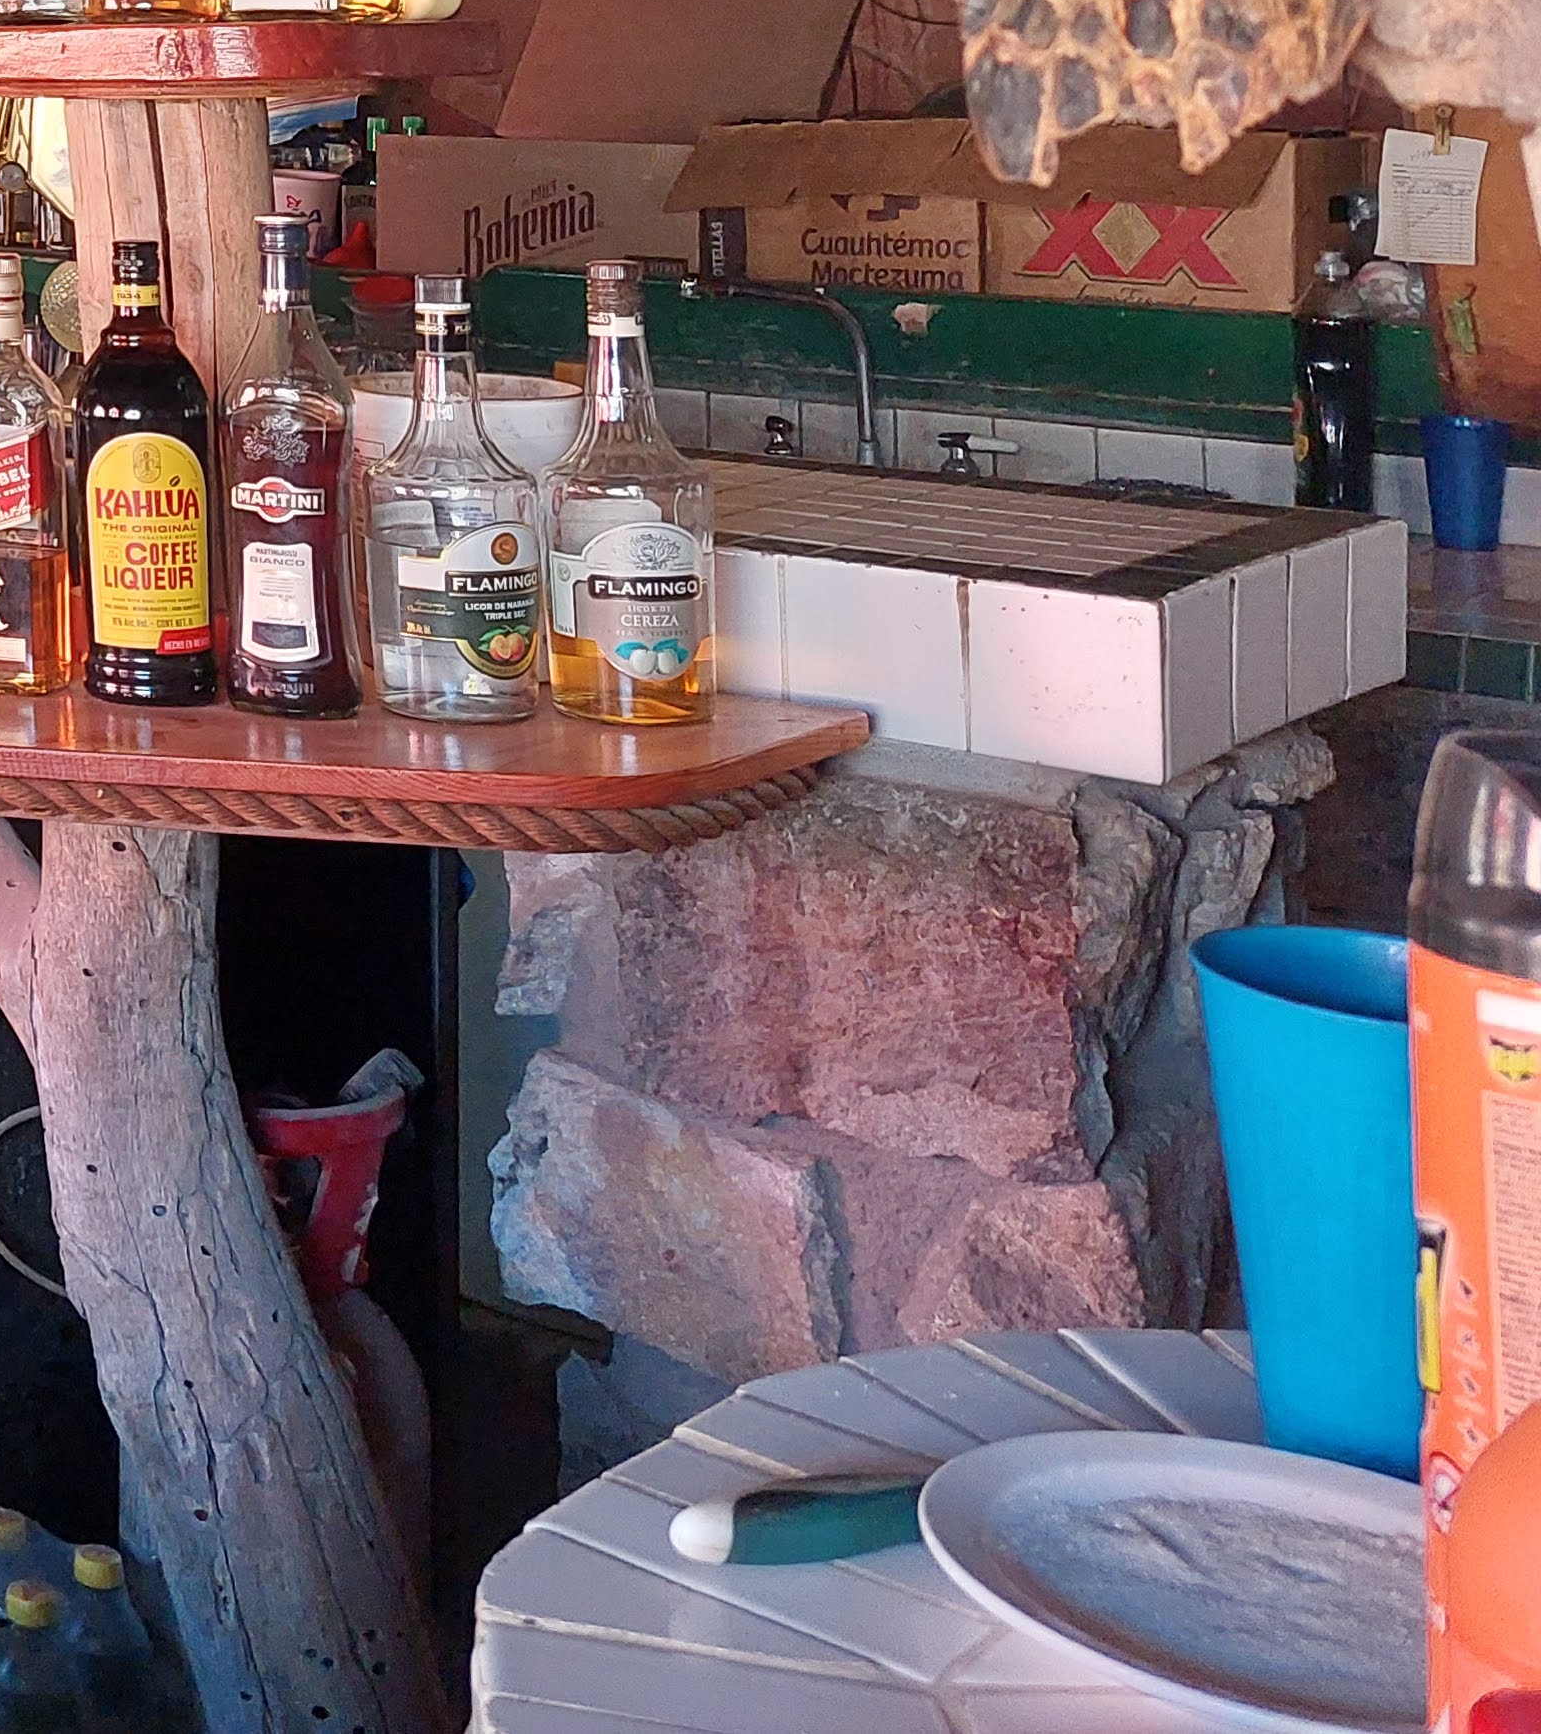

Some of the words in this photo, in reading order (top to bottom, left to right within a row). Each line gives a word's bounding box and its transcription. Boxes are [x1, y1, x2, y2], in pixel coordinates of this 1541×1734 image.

[463, 183, 595, 278] Bohemia
[710, 221, 725, 278] OTELLAS
[800, 226, 971, 260] Cuauhtémoc
[811, 259, 964, 291] Moctezuma
[94, 476, 200, 521] KAHLÚA
[237, 487, 319, 510] MARTINI
[101, 523, 128, 533] THE
[131, 523, 198, 534] ORIGINAL
[124, 540, 198, 566] COFFEE
[249, 556, 306, 567] BIANCO
[103, 564, 194, 591] LIQUEUR
[451, 571, 539, 592] FLAMINGO
[594, 579, 699, 597] FLAMINGO
[464, 602, 493, 611] LICOR
[494, 601, 506, 610] DE
[483, 611, 513, 621] TRIPLE
[627, 605, 657, 614] LICOR
[620, 613, 680, 628] CEREZA
